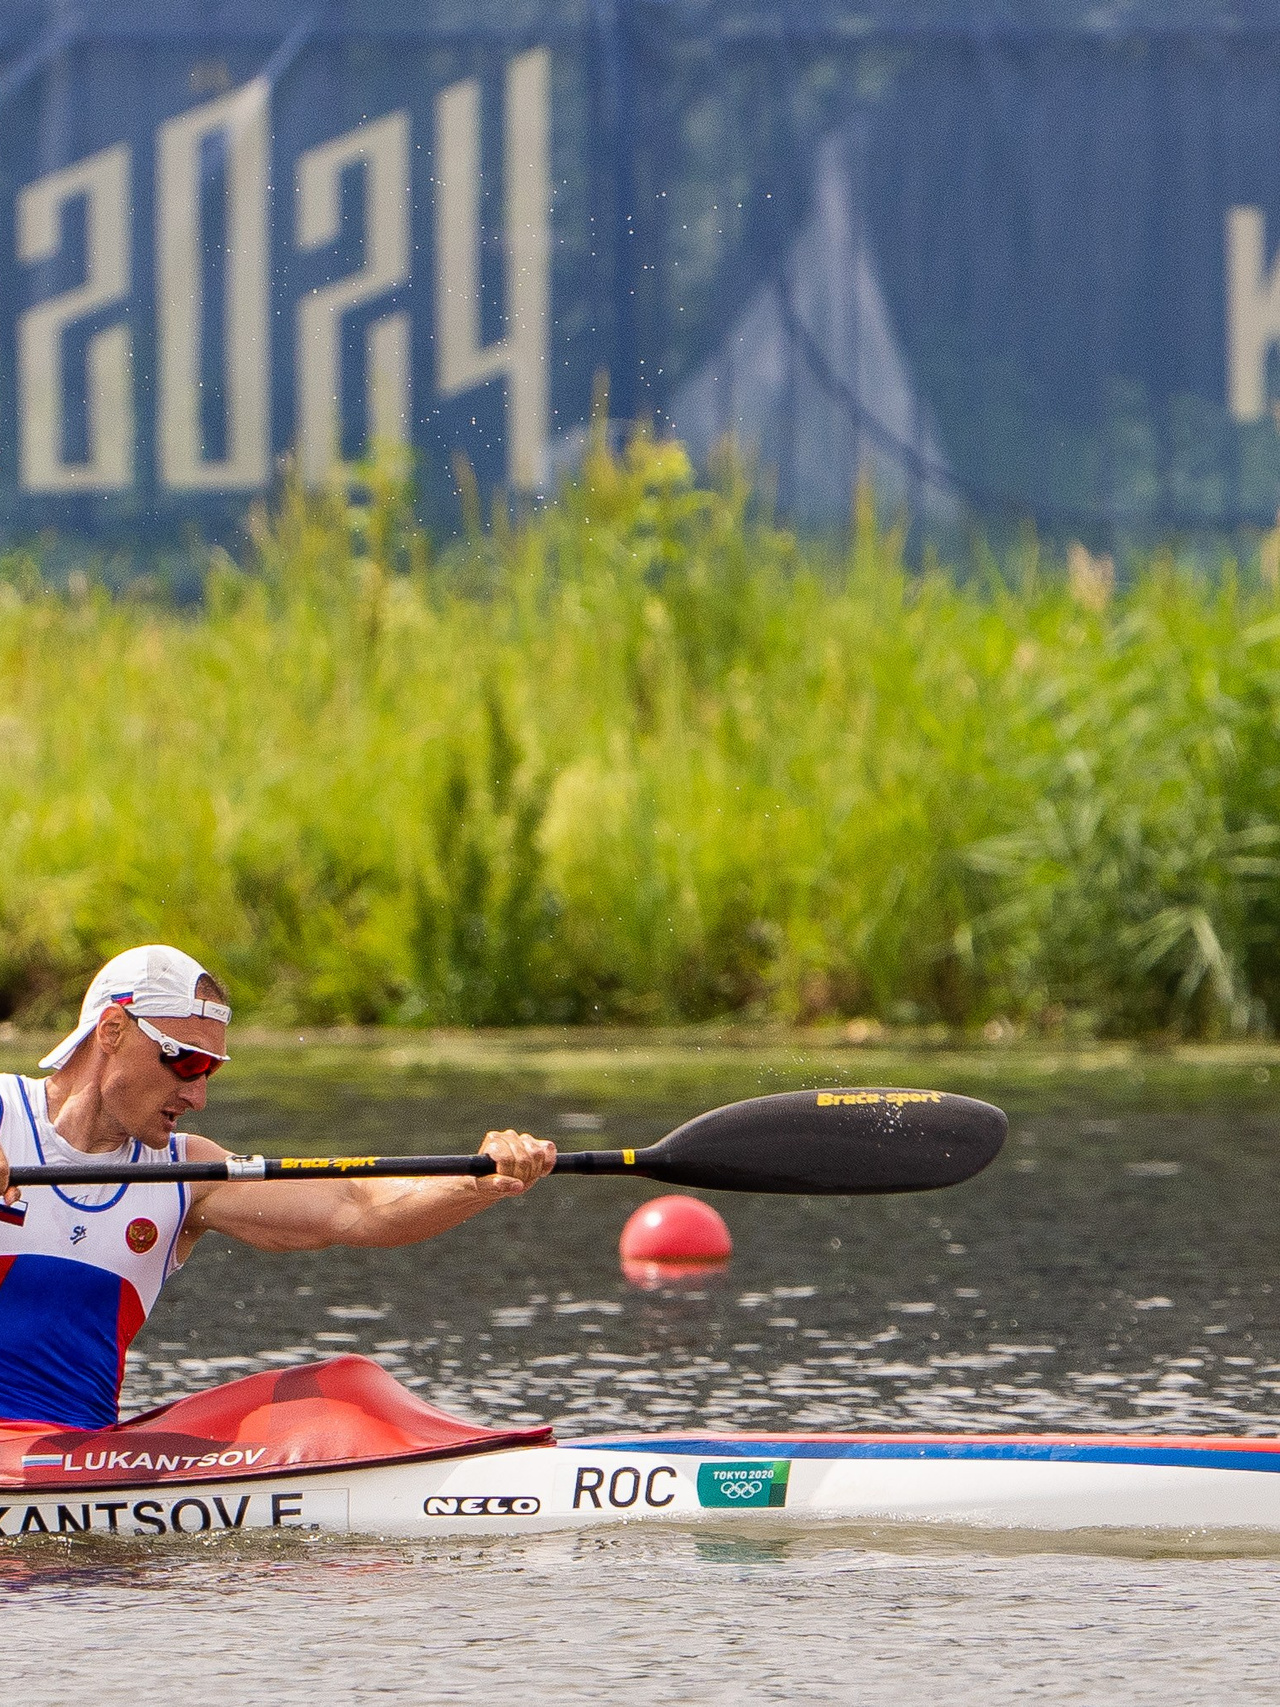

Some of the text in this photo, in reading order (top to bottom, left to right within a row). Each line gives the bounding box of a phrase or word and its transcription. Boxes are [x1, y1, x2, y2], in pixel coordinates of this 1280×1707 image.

[63, 1447, 267, 1472] LUKANTSOV
[713, 1469, 774, 1480] TOKYO 2020
[572, 1466, 677, 1509] ROC
[427, 1497, 538, 1514] NELO
